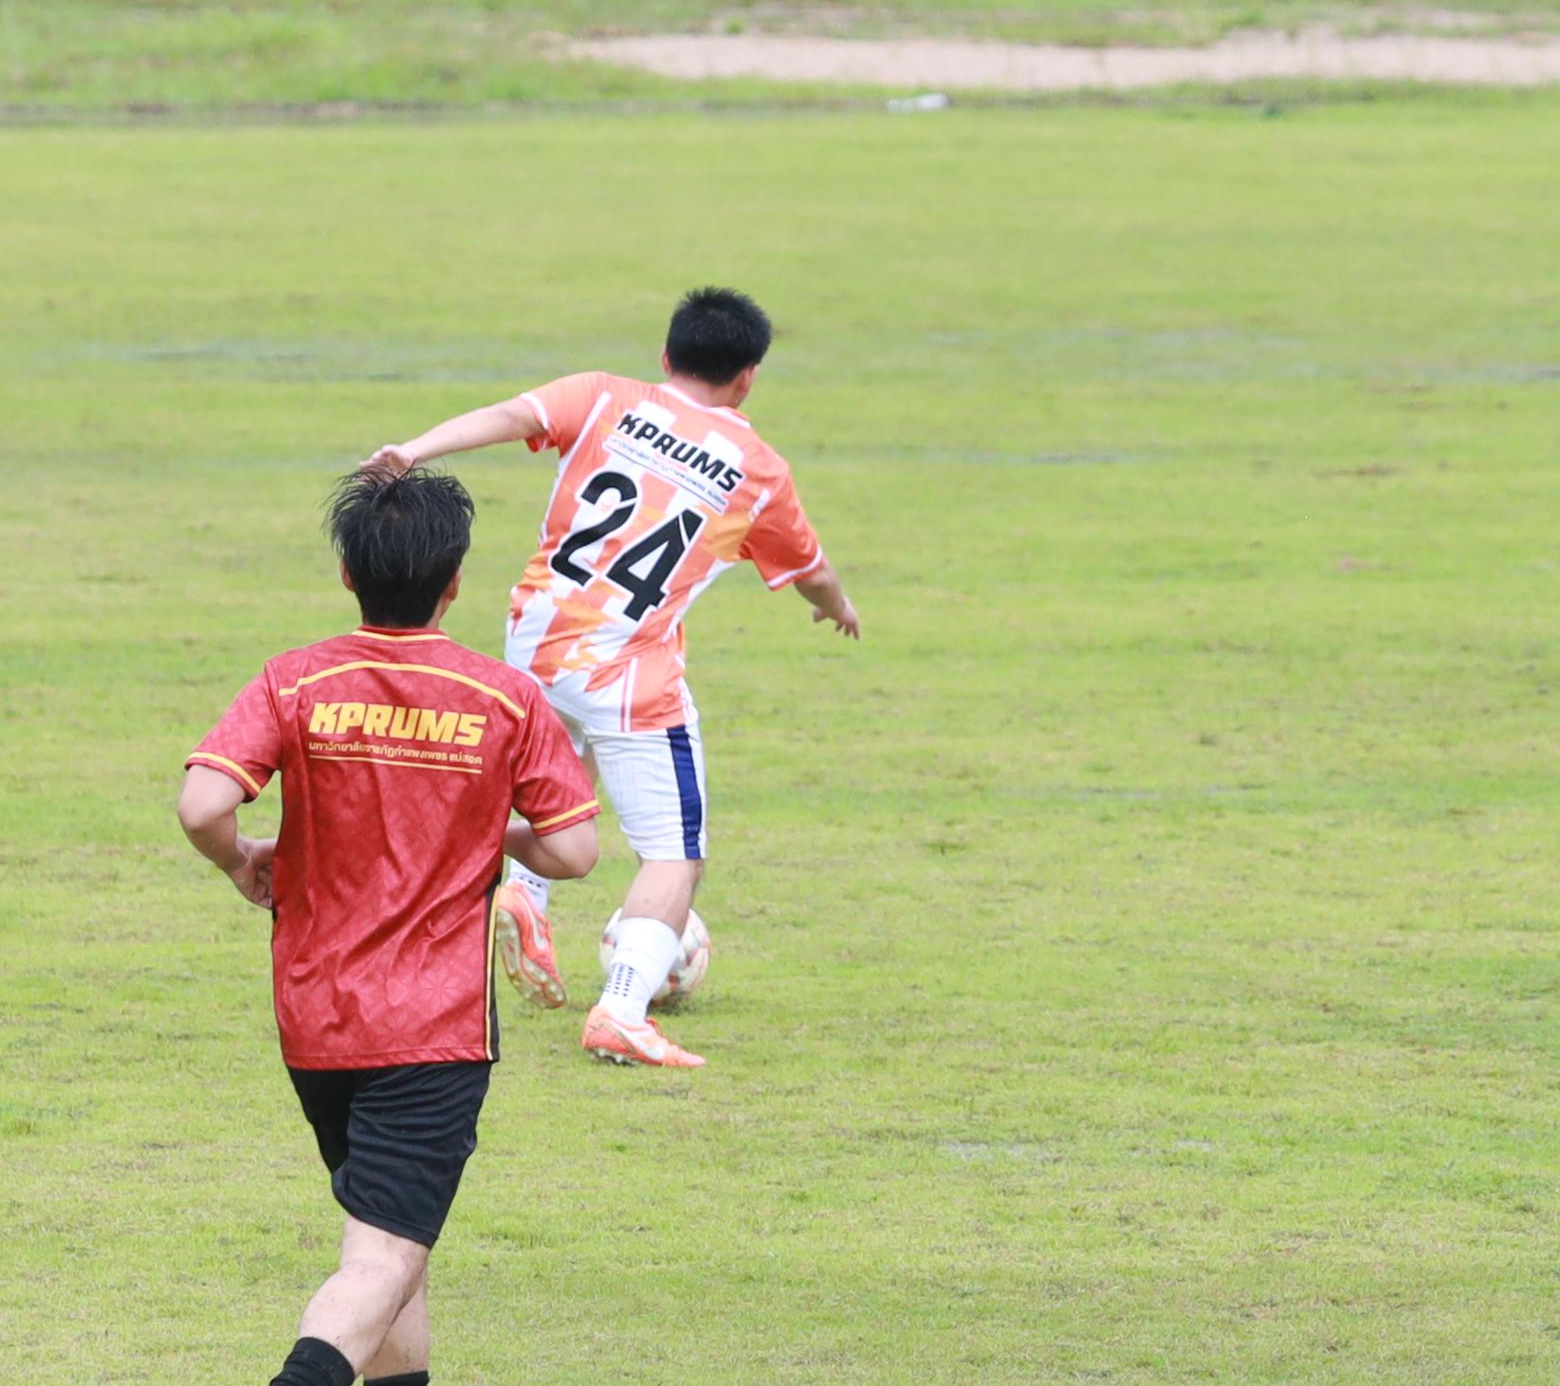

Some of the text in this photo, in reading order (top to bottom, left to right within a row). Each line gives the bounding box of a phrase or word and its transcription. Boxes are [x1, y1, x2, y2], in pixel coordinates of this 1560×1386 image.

[618, 413, 744, 492] KPRUMS
[550, 471, 705, 622] 24
[308, 702, 487, 747] KPRUMS
